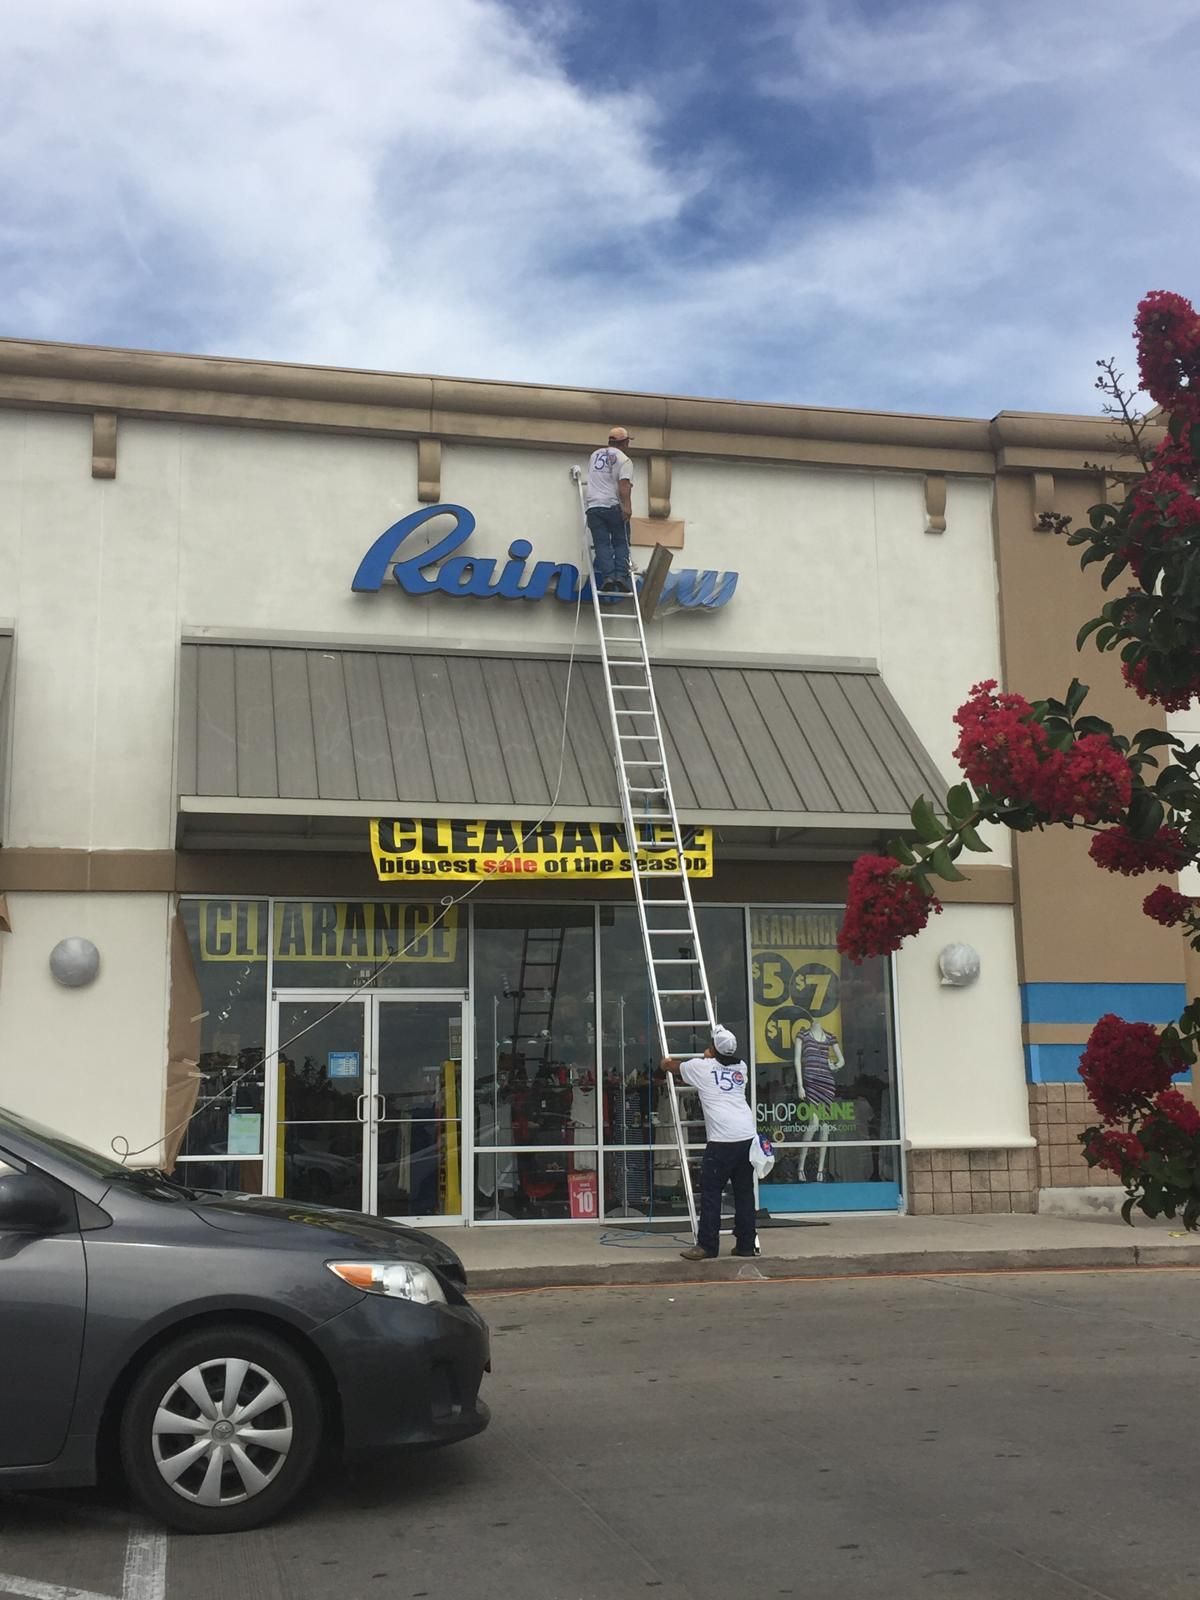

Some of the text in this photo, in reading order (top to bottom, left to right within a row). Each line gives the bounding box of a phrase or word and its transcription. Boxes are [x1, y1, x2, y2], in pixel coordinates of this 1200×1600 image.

[351, 503, 739, 608] Rainw
[379, 856, 707, 874] biggest sale of the season
[751, 962, 832, 1010] $5 $7
[757, 1101, 856, 1122] SHOP ONLINE
